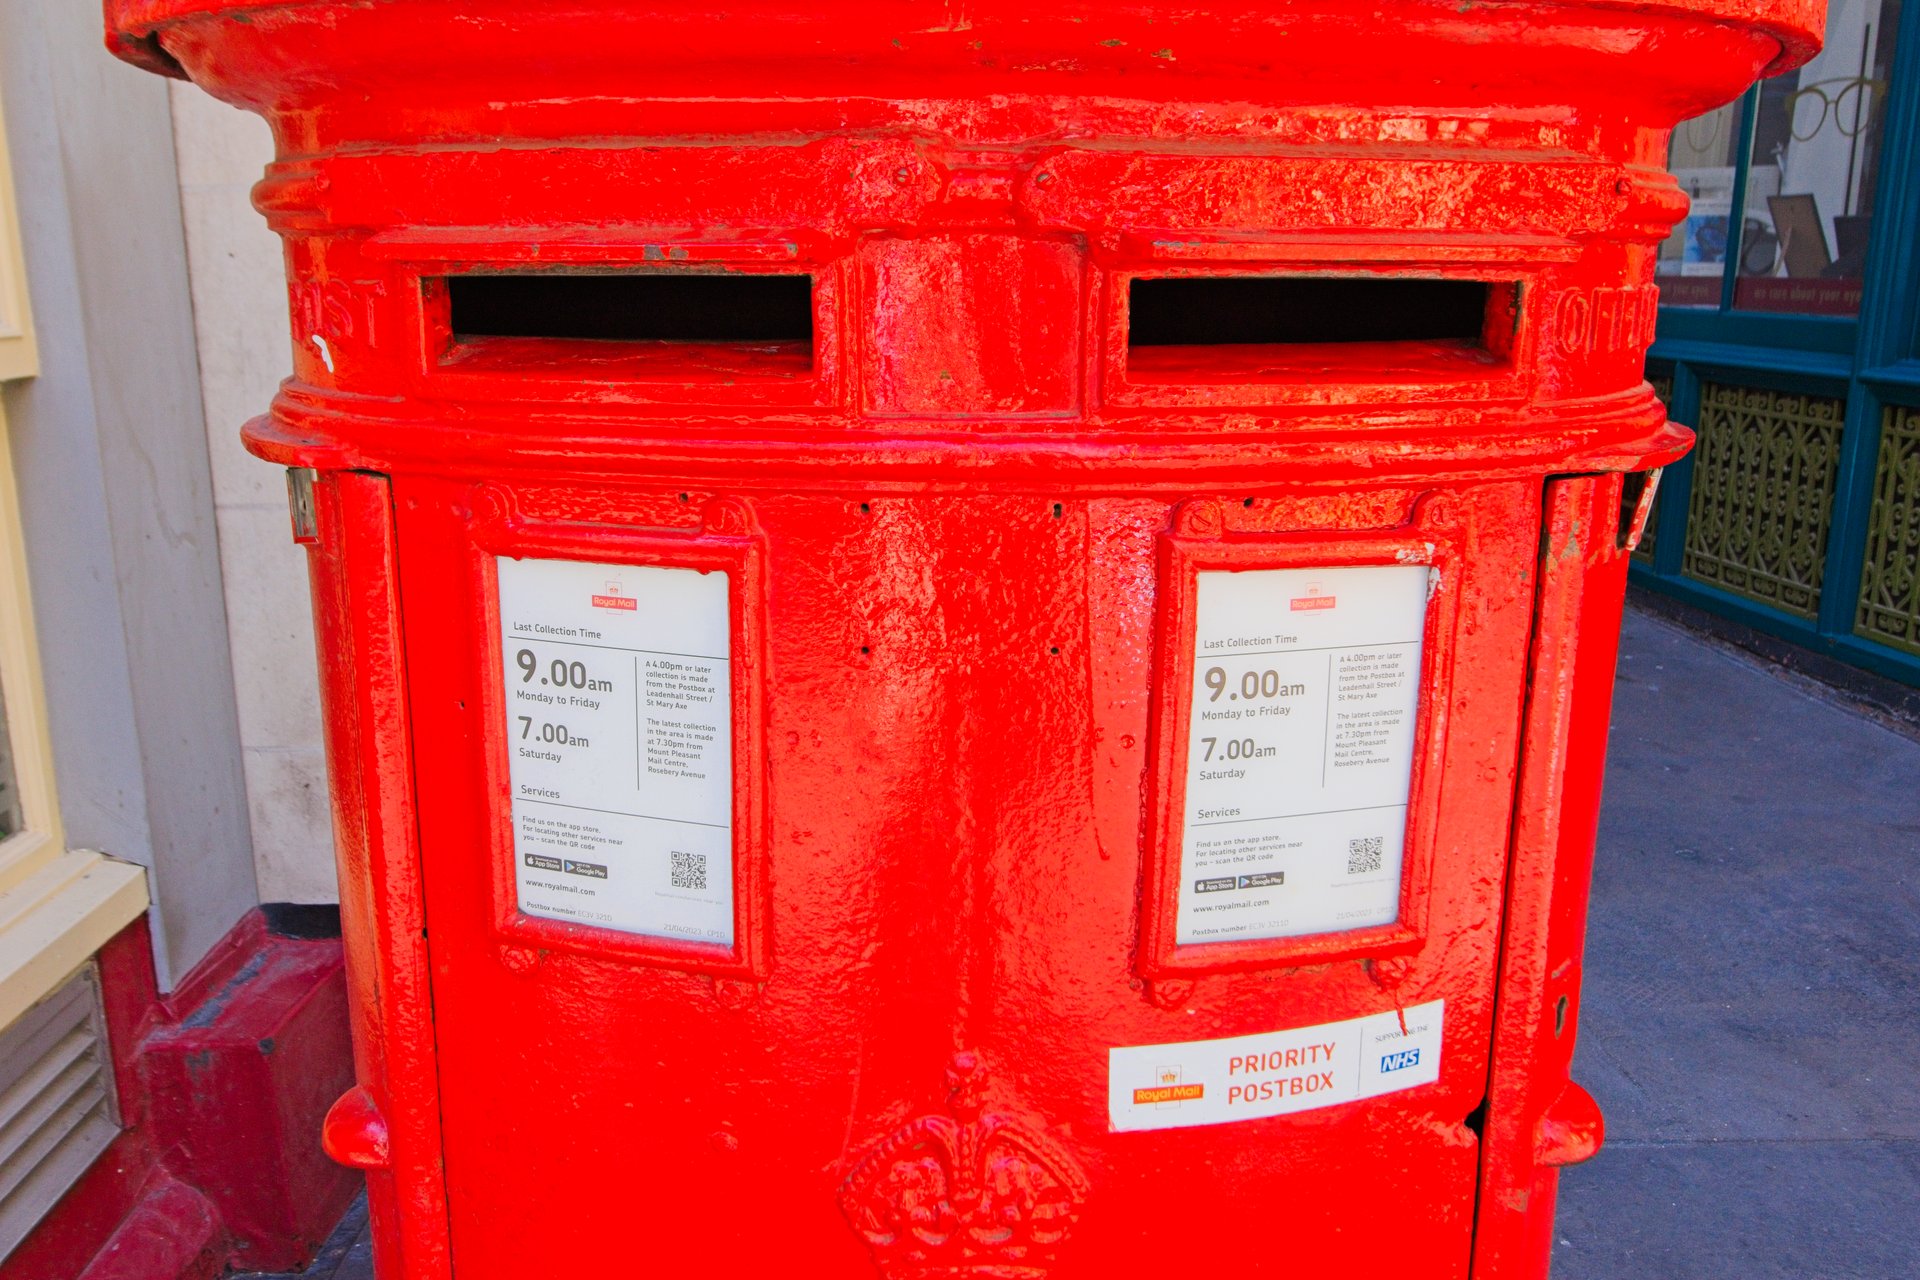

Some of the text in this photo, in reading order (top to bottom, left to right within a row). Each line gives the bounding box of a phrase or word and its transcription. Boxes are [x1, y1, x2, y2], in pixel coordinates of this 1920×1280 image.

[593, 597, 635, 608] Royal Mail
[1292, 598, 1332, 610] Royal Mail
[513, 621, 602, 639] Last Collection Time
[1204, 635, 1298, 649] Last Collection Time
[1346, 653, 1375, 663] 4.00pm
[1386, 652, 1402, 660] later
[516, 648, 613, 692] 9.00am
[652, 660, 683, 671] 4.00pm
[694, 665, 711, 674] later
[1339, 664, 1371, 673] collection
[646, 671, 679, 680] collection
[689, 675, 708, 683] made
[1370, 672, 1396, 680] Postbox
[646, 680, 663, 688] from
[664, 682, 677, 690] the
[678, 683, 706, 692] Postbox
[1204, 666, 1305, 702] 9.00am
[1338, 681, 1397, 692] Leadenhall Street
[516, 690, 600, 710] Monday to Friday
[646, 690, 708, 703] Leadenhall Street
[1347, 693, 1364, 701] Mary
[656, 699, 674, 709] Mary
[675, 702, 688, 710] Axe
[1201, 706, 1291, 720] Monday to Friday
[1351, 711, 1370, 719] latest
[1372, 709, 1403, 717] collection
[518, 715, 589, 748] 7.00am
[646, 718, 717, 732] The latest collection
[1344, 721, 1356, 729] the
[647, 727, 654, 735] in
[655, 729, 667, 737] the
[694, 733, 714, 741] made
[1345, 730, 1371, 739] 7.30pm
[1373, 729, 1390, 737] from
[656, 739, 684, 749] 7.30pm
[686, 743, 704, 751] from
[1201, 737, 1276, 762] 7.00am
[1335, 739, 1387, 749] Mount Pleasant
[519, 747, 562, 763] Saturday
[647, 747, 701, 760] Mount Pleasant
[1334, 749, 1374, 758] Mail Centre,
[647, 757, 688, 768] Mail Centre,
[1334, 757, 1390, 768] Rosebery Avenue
[648, 766, 706, 779] Rosebery Avenue
[1199, 768, 1246, 781] Saturday
[520, 784, 560, 799] Services
[1197, 807, 1241, 819] Services
[522, 816, 536, 824] Find
[556, 821, 567, 829] the
[582, 825, 601, 834] store.
[522, 824, 533, 832] For
[534, 826, 559, 837] locating
[561, 831, 578, 839] other
[580, 834, 606, 844] services
[541, 837, 555, 845] scan
[556, 839, 568, 847] the
[569, 840, 579, 849] QR
[580, 843, 595, 851] code
[1195, 850, 1207, 858] For
[1209, 848, 1236, 857] locating
[1258, 843, 1286, 851] services
[1194, 859, 1208, 868] you
[1215, 857, 1231, 865] scan
[1232, 855, 1244, 863] the
[576, 866, 606, 878] Google Play
[1251, 878, 1270, 886] Google
[1270, 876, 1281, 884] Play
[525, 880, 596, 896] www.royalmail.com
[526, 901, 550, 911] Postbox
[552, 907, 576, 916] number
[1193, 899, 1270, 914] www.royalmail.com
[1192, 924, 1247, 936] Postbox number
[1229, 1041, 1336, 1076] PRIORITY
[1382, 1049, 1419, 1073] NHS
[1136, 1086, 1200, 1102] Royal Mail
[1228, 1070, 1334, 1105] POSTBOX
